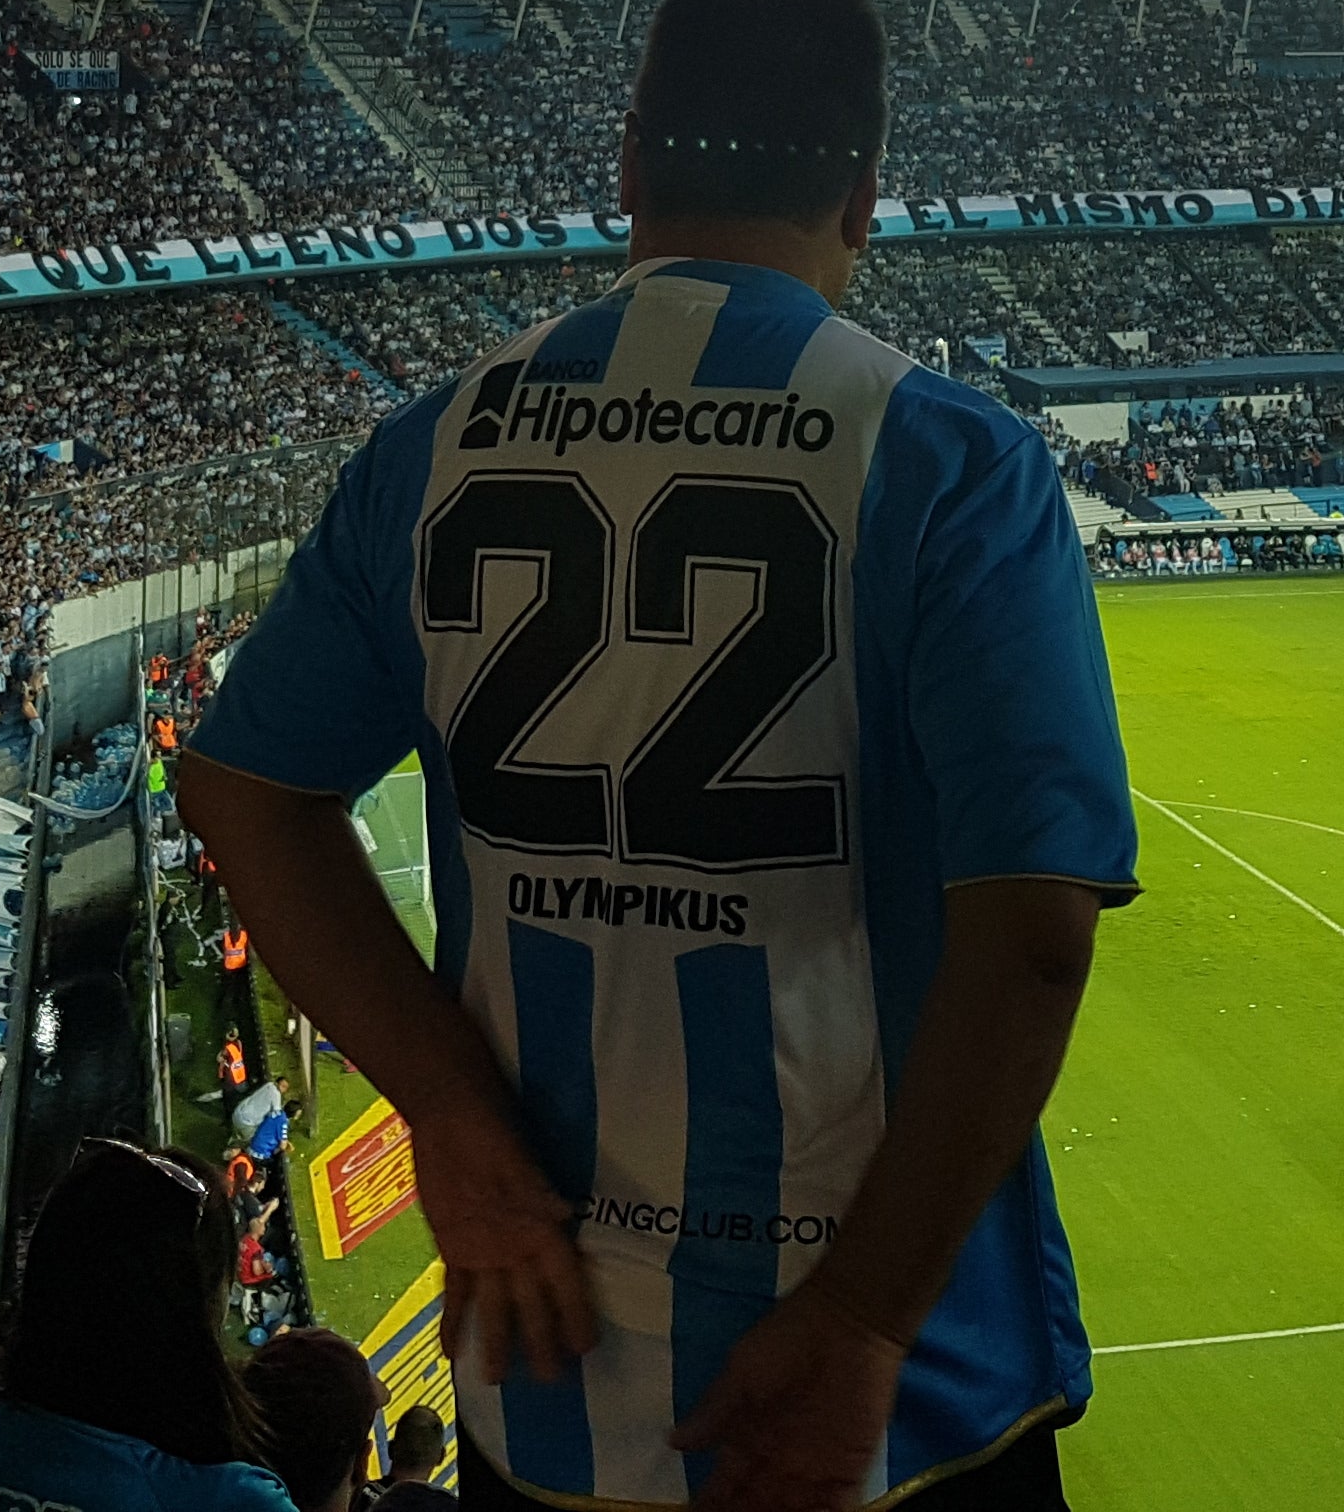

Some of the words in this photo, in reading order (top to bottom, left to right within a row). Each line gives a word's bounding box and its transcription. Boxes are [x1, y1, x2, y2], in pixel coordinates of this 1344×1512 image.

[89, 50, 111, 69] QUE
[33, 240, 171, 290] QUE
[185, 222, 416, 276] LLENO
[442, 213, 568, 251] DOS
[904, 197, 989, 232] EL
[508, 386, 836, 458] Hipotecario
[421, 468, 850, 874] 22
[508, 873, 749, 937] OLYMPIKUS
